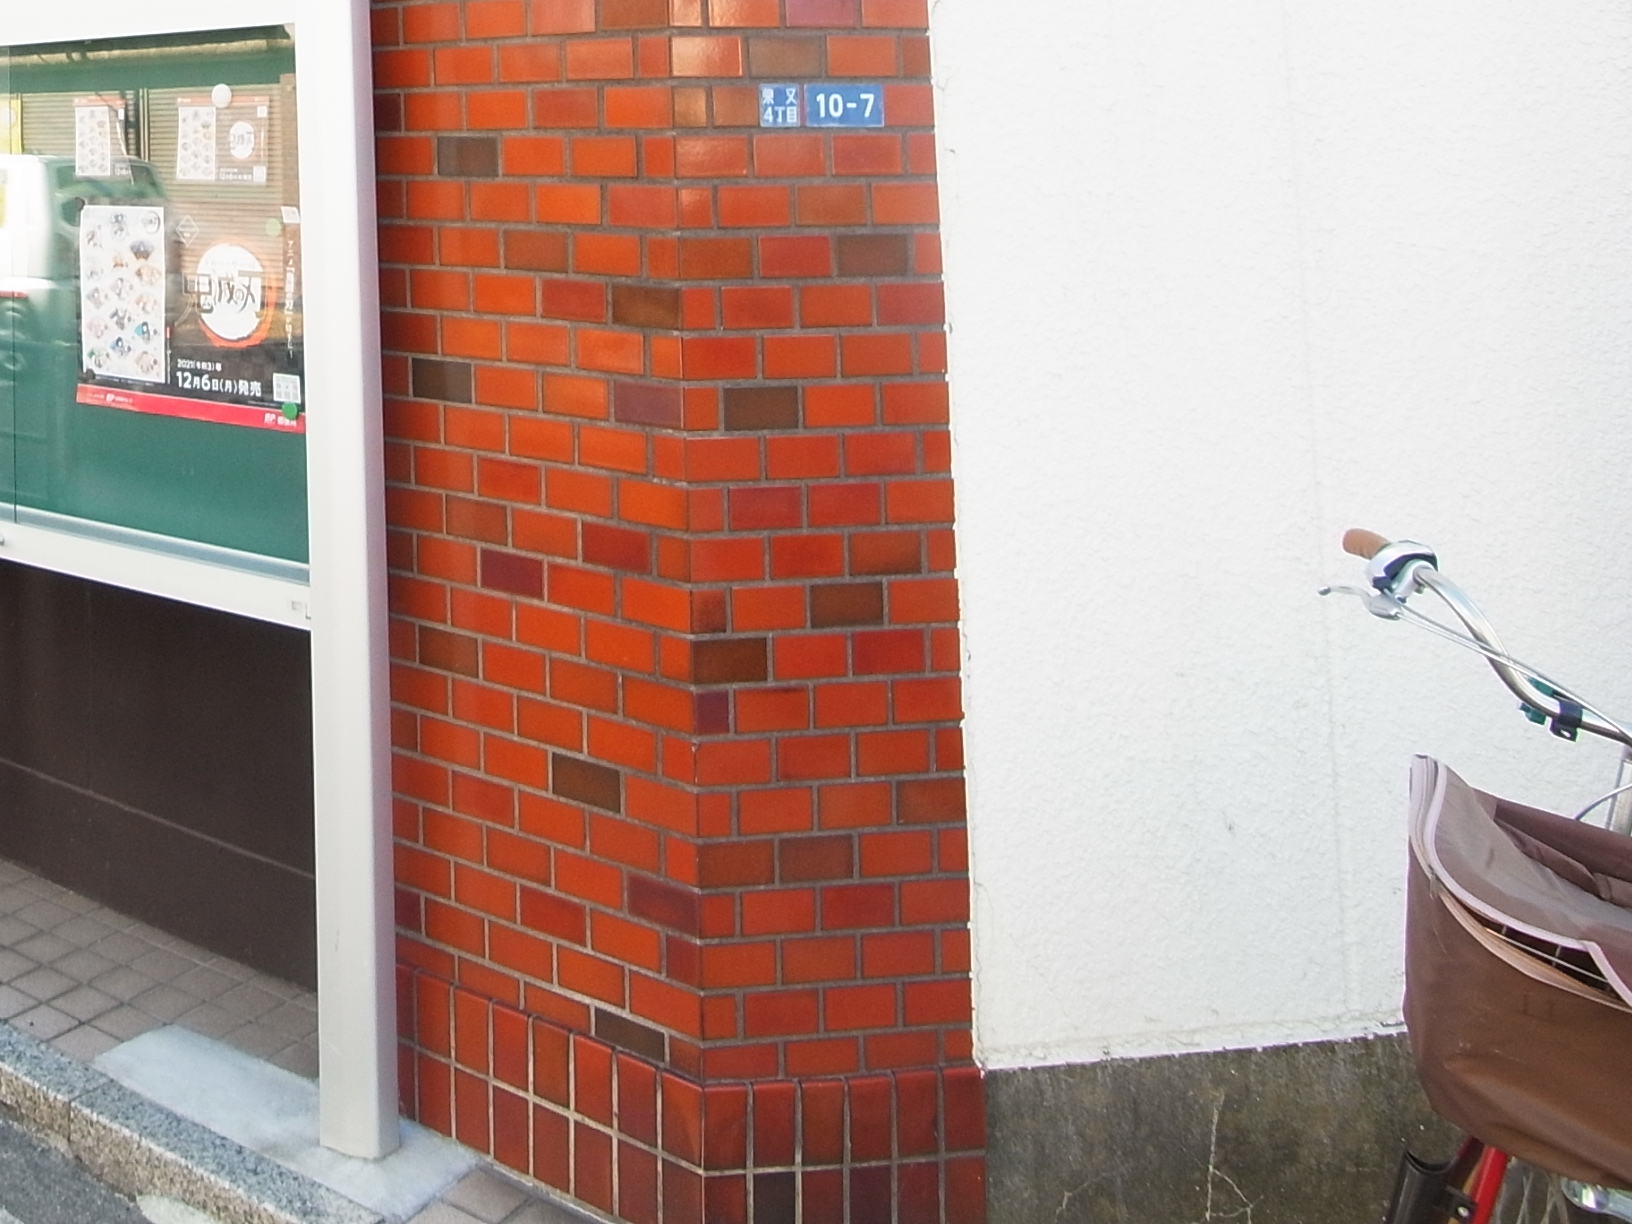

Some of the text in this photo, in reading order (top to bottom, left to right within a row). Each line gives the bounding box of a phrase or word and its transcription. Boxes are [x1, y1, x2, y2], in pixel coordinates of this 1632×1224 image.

[763, 106, 797, 123] 4丁目
[816, 93, 875, 118] 10-7
[176, 371, 262, 398] 12月6日(月)発売
